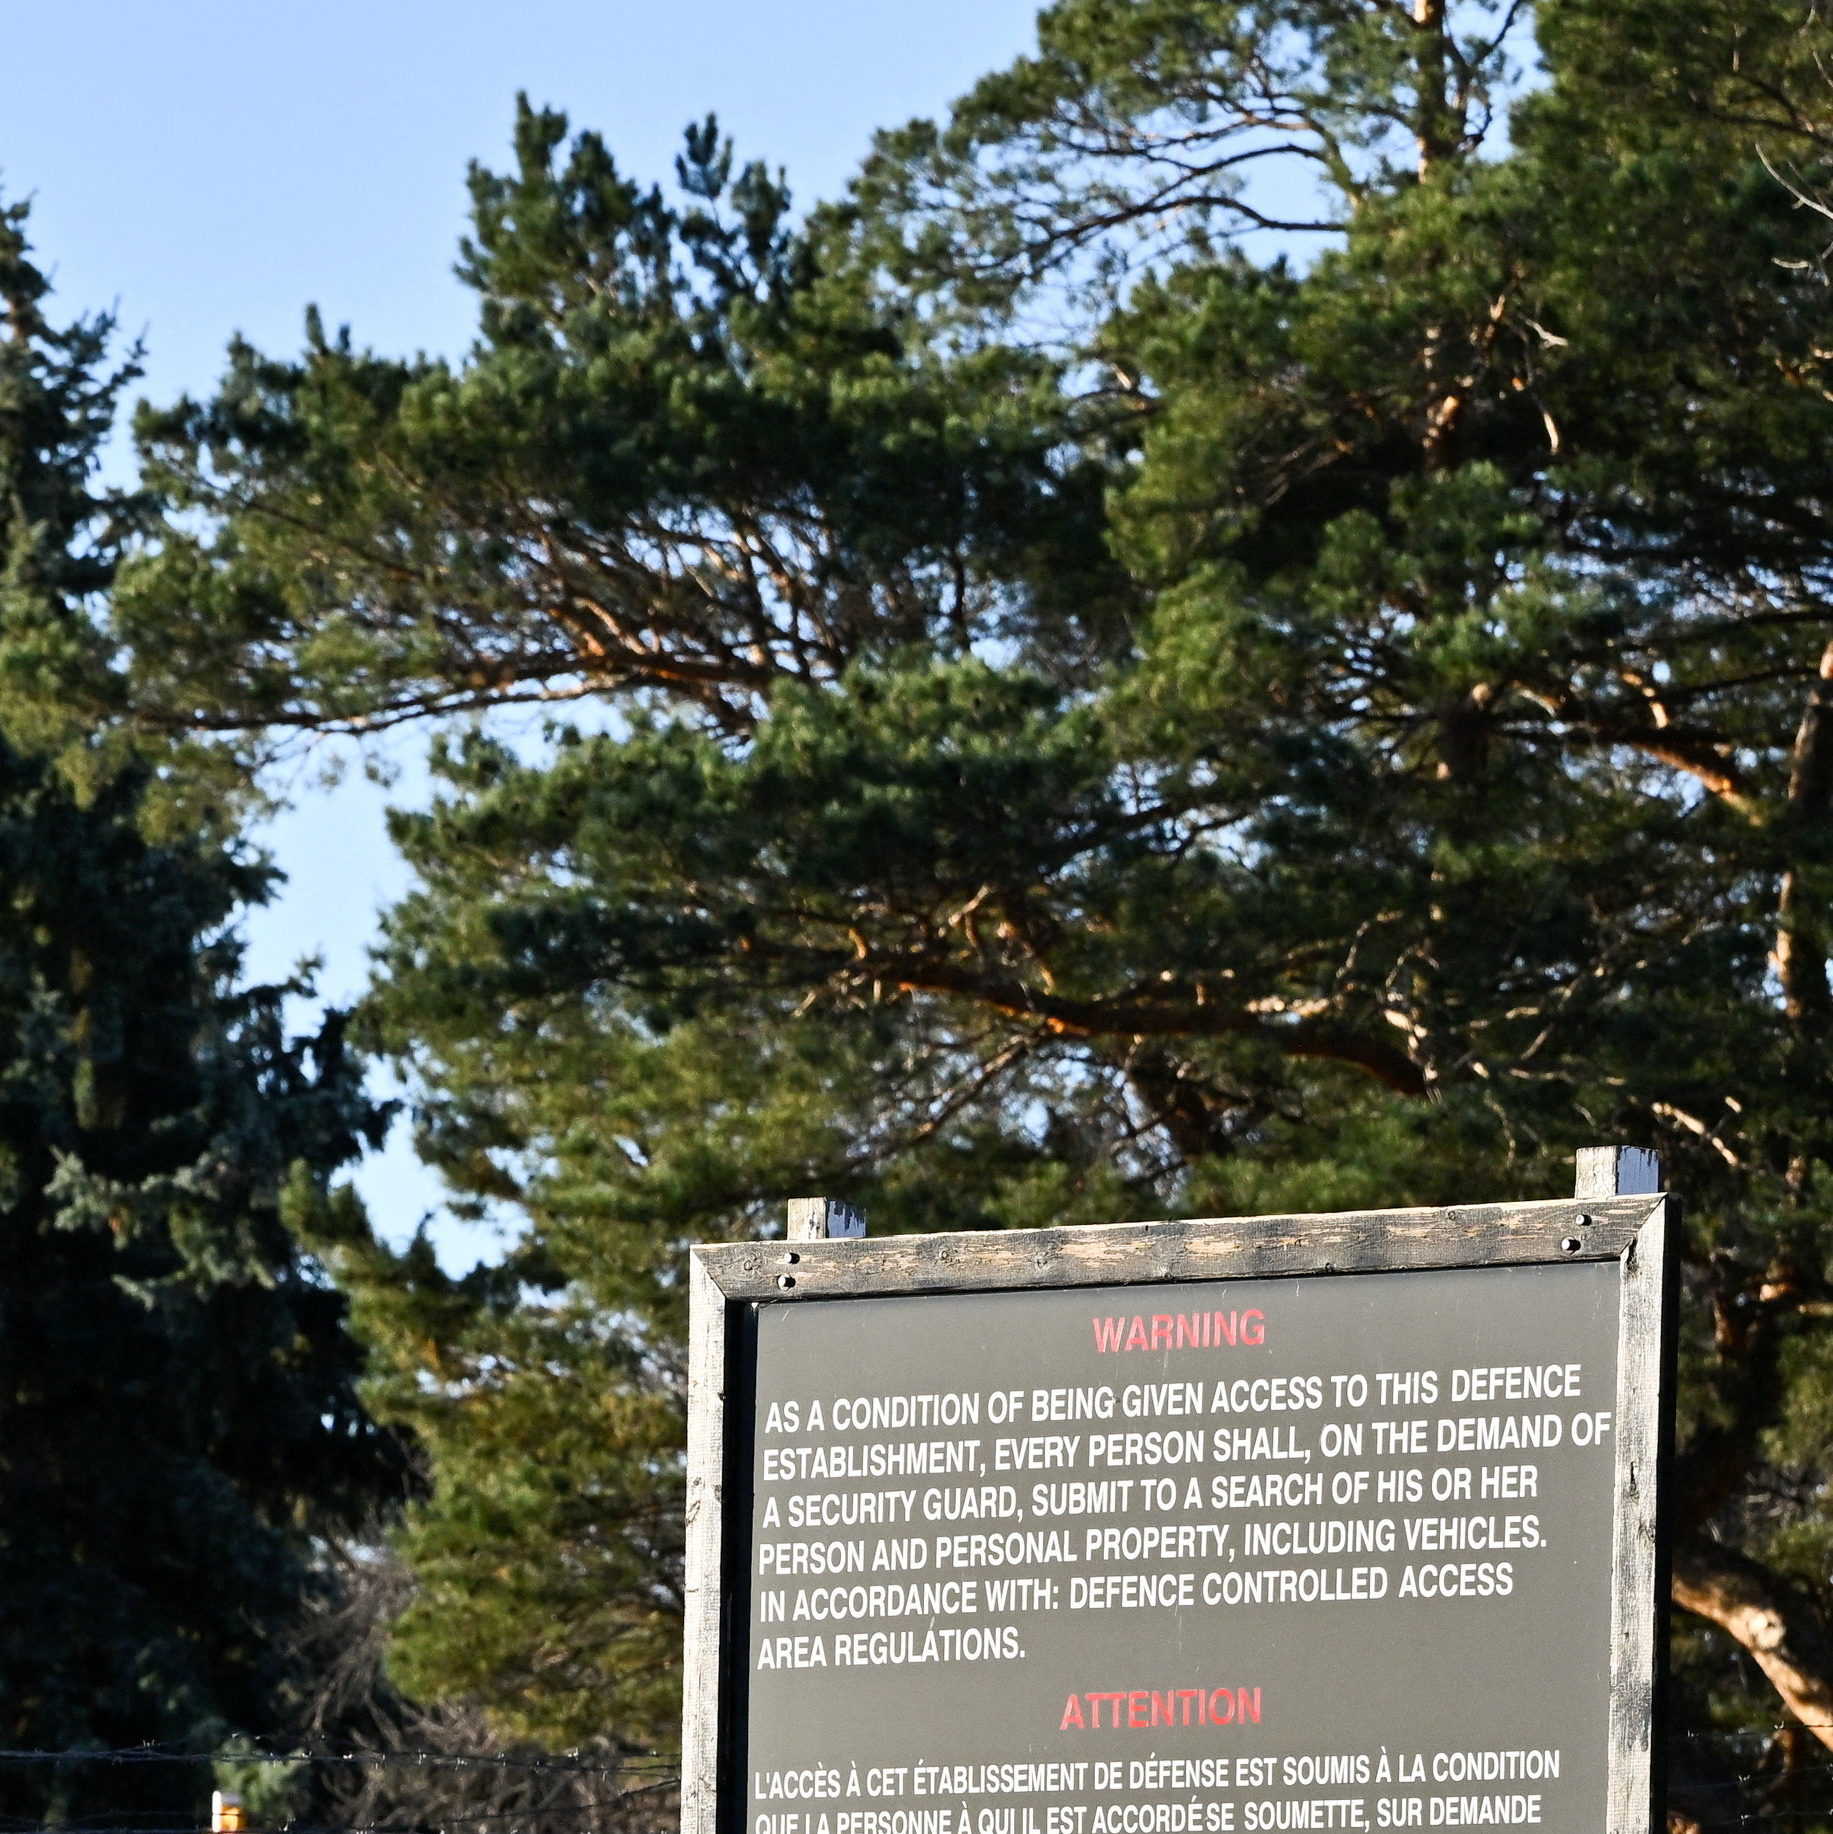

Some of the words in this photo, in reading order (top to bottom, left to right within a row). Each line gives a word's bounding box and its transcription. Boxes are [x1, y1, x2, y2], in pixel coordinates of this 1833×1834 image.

[1093, 1308, 1266, 1353] WARNING
[764, 1399, 801, 1435] AS
[805, 1399, 826, 1433] A
[831, 1392, 981, 1432] CONDITION
[987, 1390, 1026, 1425] OF
[1031, 1385, 1117, 1423] BEING
[1121, 1381, 1205, 1419] GIVEN
[1210, 1375, 1324, 1415] ACCESS
[1330, 1373, 1369, 1409] TO
[1375, 1369, 1439, 1407] THIS
[1451, 1363, 1583, 1403] DEFENCE
[762, 1439, 987, 1482] ESTABLISHMENT,
[994, 1435, 1082, 1472] EVERY
[1088, 1429, 1206, 1468] PERSON
[1212, 1425, 1312, 1466] SHALL,
[1319, 1422, 1364, 1459] ON
[1371, 1419, 1429, 1456] THE
[1436, 1413, 1564, 1453] DEMAND
[1570, 1411, 1613, 1448] OF
[761, 1496, 782, 1530] A
[787, 1489, 918, 1529] SECURITY
[922, 1485, 1024, 1524] GUARD,
[1031, 1479, 1135, 1518] SUBMIT
[1139, 1477, 1178, 1512] TO
[1183, 1476, 1204, 1511] A
[1210, 1472, 1324, 1510] SEARCH
[1331, 1470, 1371, 1506] OF
[1376, 1468, 1424, 1504] HIS
[1431, 1467, 1473, 1502] OR
[1480, 1464, 1539, 1500] HER
[758, 1539, 866, 1577] PERSON
[871, 1537, 929, 1573] AND
[935, 1529, 1079, 1570] PERSONAL
[1085, 1523, 1236, 1564] PROPERTY,
[1244, 1518, 1397, 1557] INCLUDING
[1403, 1514, 1548, 1552] VEHICLES.
[759, 1589, 787, 1624] IN
[791, 1580, 978, 1623] ACCORDANCE
[984, 1577, 1060, 1613] WITH:
[1069, 1573, 1196, 1610] DEFENCE
[1202, 1566, 1389, 1607] CONTROLLED
[1397, 1561, 1515, 1599] ACCESS
[756, 1635, 829, 1671] AREA
[834, 1625, 1027, 1667] REGULATIONS.
[1060, 1687, 1262, 1731] ATTENTION
[754, 1761, 842, 1801] L'ACCÈS
[845, 1759, 863, 1798] À
[866, 1767, 909, 1798] CET
[913, 1757, 1090, 1796] ÉTABLISSEMENT
[1094, 1761, 1124, 1791] DE
[1129, 1751, 1230, 1790] DÉFENSE
[1235, 1756, 1279, 1788] EST
[1282, 1754, 1371, 1787] SOUMIS
[1375, 1745, 1393, 1784] À
[1398, 1753, 1428, 1784] LA
[1432, 1749, 1561, 1783] CONDITION
[1091, 1794, 1204, 1834] ACCORDÉ
[1205, 1802, 1236, 1833] SE
[1243, 1798, 1371, 1834] SOUMETTE,
[1376, 1797, 1424, 1829] SUR
[1429, 1794, 1543, 1827] DEMANDE
